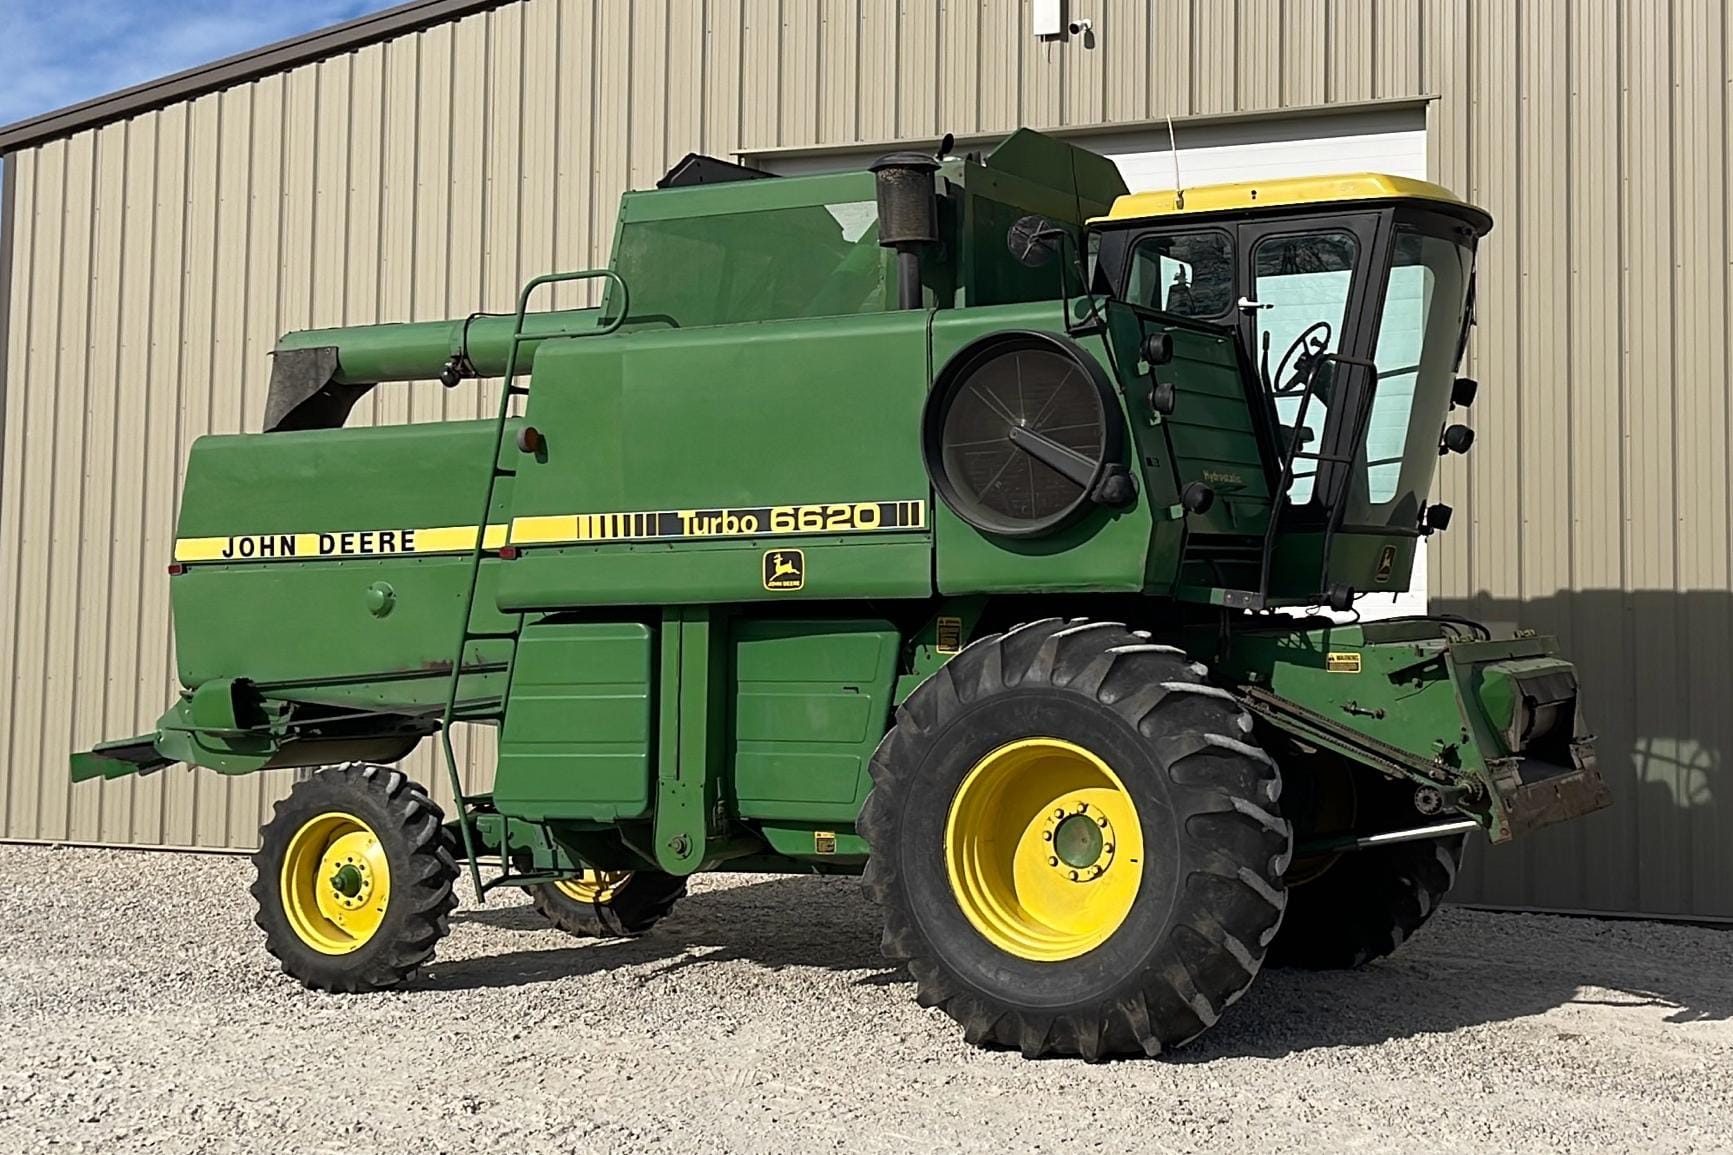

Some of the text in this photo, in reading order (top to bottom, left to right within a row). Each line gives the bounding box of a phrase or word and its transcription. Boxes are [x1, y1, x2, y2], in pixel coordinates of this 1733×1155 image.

[677, 502, 881, 536] Turbo 6620
[222, 530, 415, 558] JOHN DEERE
